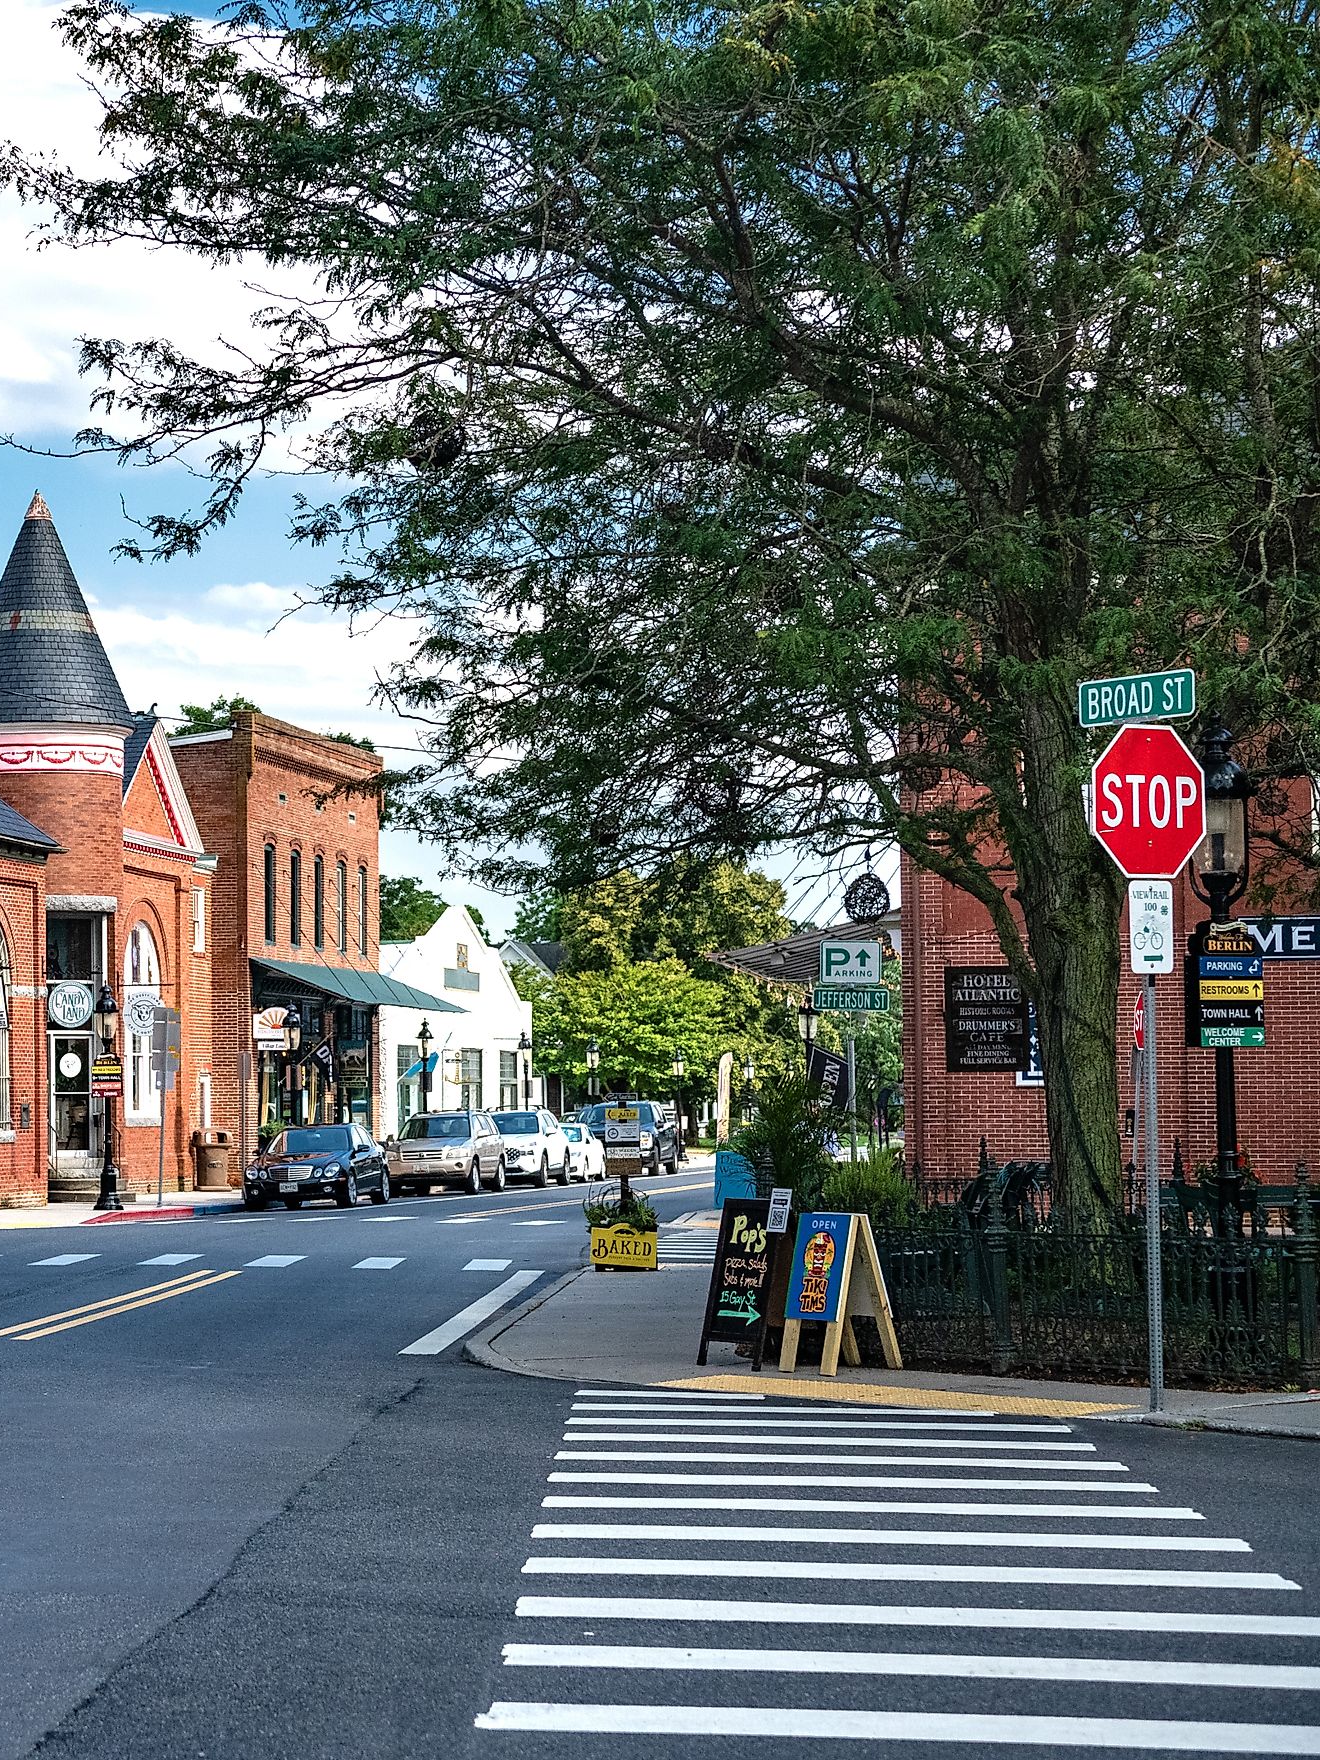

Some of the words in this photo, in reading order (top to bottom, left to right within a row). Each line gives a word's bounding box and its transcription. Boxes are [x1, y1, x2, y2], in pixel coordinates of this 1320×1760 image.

[1087, 681, 1153, 719] BROAD
[1162, 677, 1185, 711] ST
[1101, 773, 1197, 829] STOP
[1144, 902, 1158, 911] 100
[1207, 939, 1253, 951] BERLIN
[1206, 961, 1243, 971] PARKING
[963, 975, 1011, 988] HOTEL
[955, 988, 1020, 1001] ATLANTIC
[1201, 986, 1250, 995] RESTROOMS
[55, 991, 86, 1008] CANDY
[815, 991, 871, 1009] JEFFERSON
[874, 992, 886, 1009] ST
[62, 1005, 86, 1021] LAND
[959, 1007, 991, 1016] HISTORIC
[1202, 1009, 1227, 1018] TOWN
[1228, 1009, 1251, 1018] HALL
[958, 1020, 1016, 1031] DRUMMER'S
[970, 1032, 1005, 1042] CAFE
[1205, 1027, 1245, 1037] WELCOME
[1208, 1037, 1241, 1046] CENTER
[960, 1057, 976, 1065] FULL
[976, 1057, 1003, 1065] SERVICE
[811, 1220, 837, 1229] OPEN
[730, 1215, 767, 1253] Pop's
[592, 1238, 652, 1259] BAKED
[720, 1290, 729, 1302] 15
[729, 1290, 745, 1311] Gay
